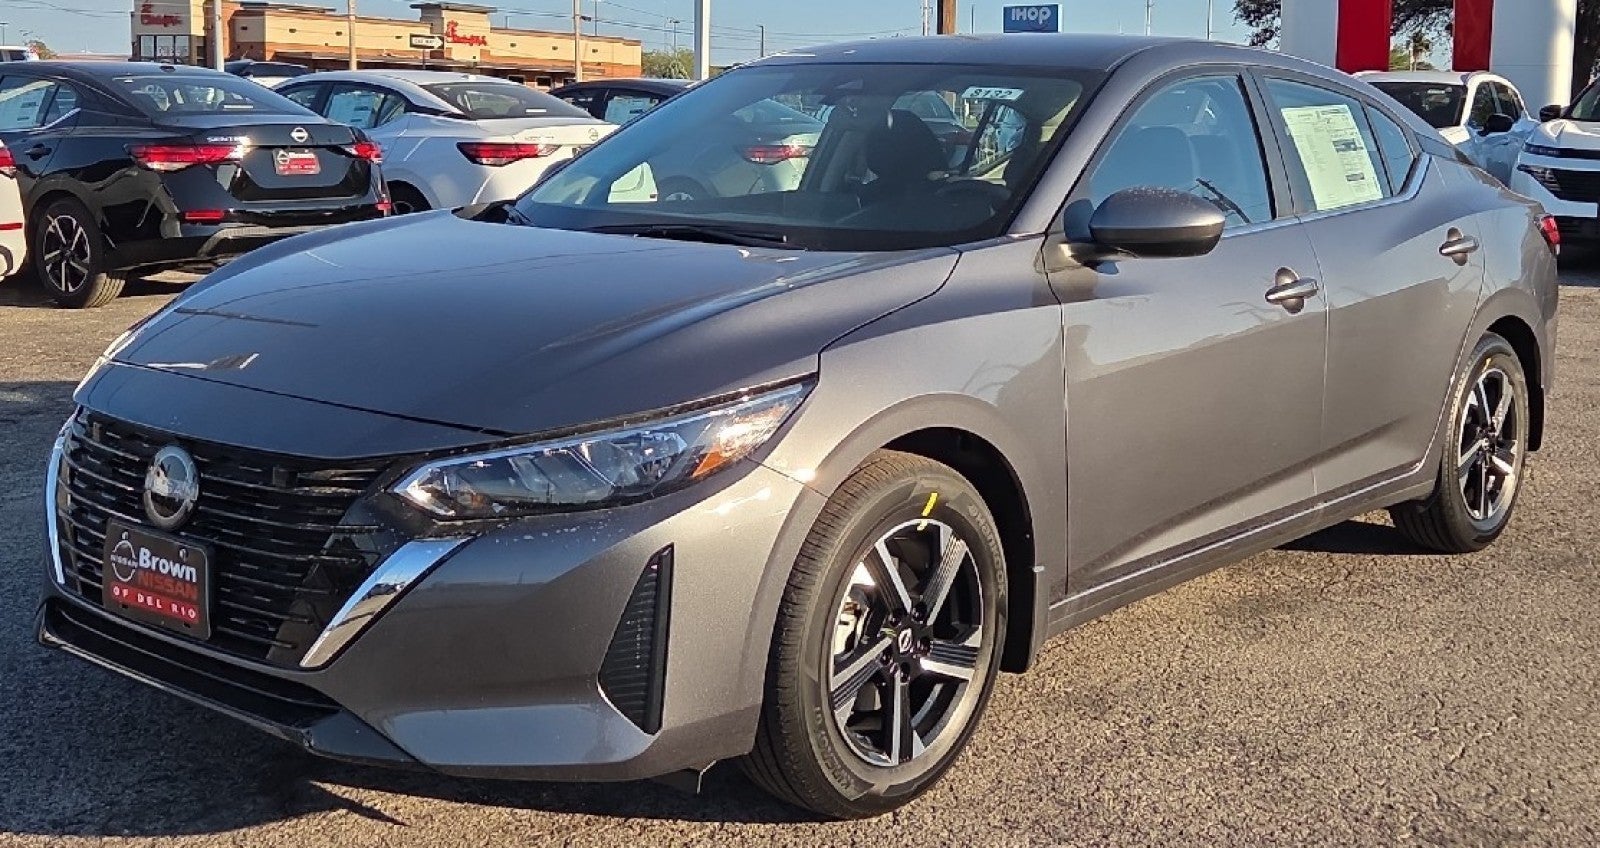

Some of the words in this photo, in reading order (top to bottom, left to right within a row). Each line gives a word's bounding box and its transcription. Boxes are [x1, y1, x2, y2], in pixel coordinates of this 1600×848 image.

[1011, 6, 1051, 25] IHOP
[969, 88, 1013, 99] 8132
[138, 546, 198, 584] Brown
[137, 570, 199, 600] NISSAN
[112, 585, 129, 598] OF
[137, 592, 163, 610] DEL
[171, 602, 197, 620] RIO
